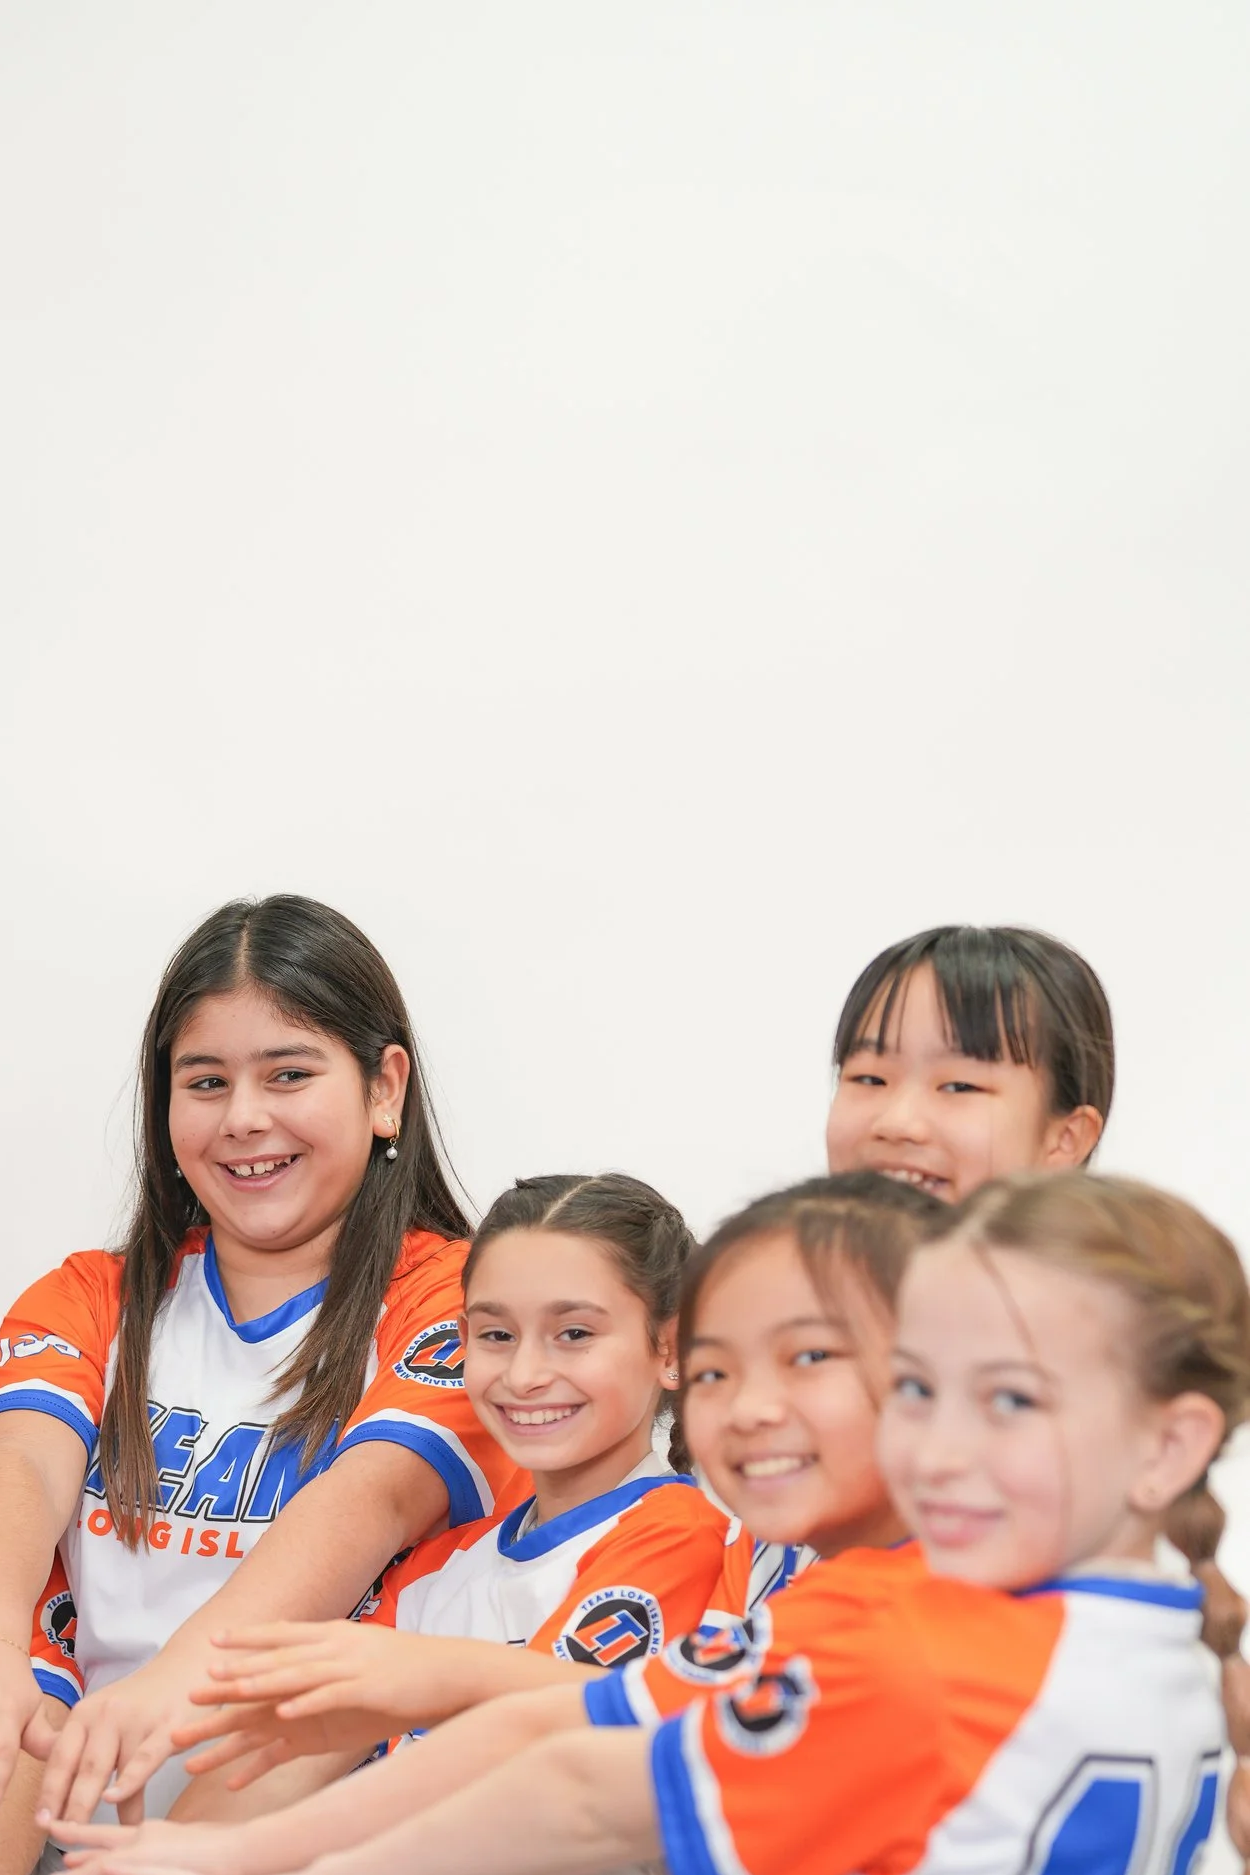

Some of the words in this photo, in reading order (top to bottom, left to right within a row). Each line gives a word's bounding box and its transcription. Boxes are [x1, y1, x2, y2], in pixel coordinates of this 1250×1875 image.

[405, 1331, 430, 1357] TEAM
[432, 1321, 458, 1333] LON
[180, 1526, 246, 1559] ISL
[581, 1590, 615, 1612] TEAM
[620, 1589, 653, 1607] LONG
[648, 1607, 661, 1655] ISLAND
